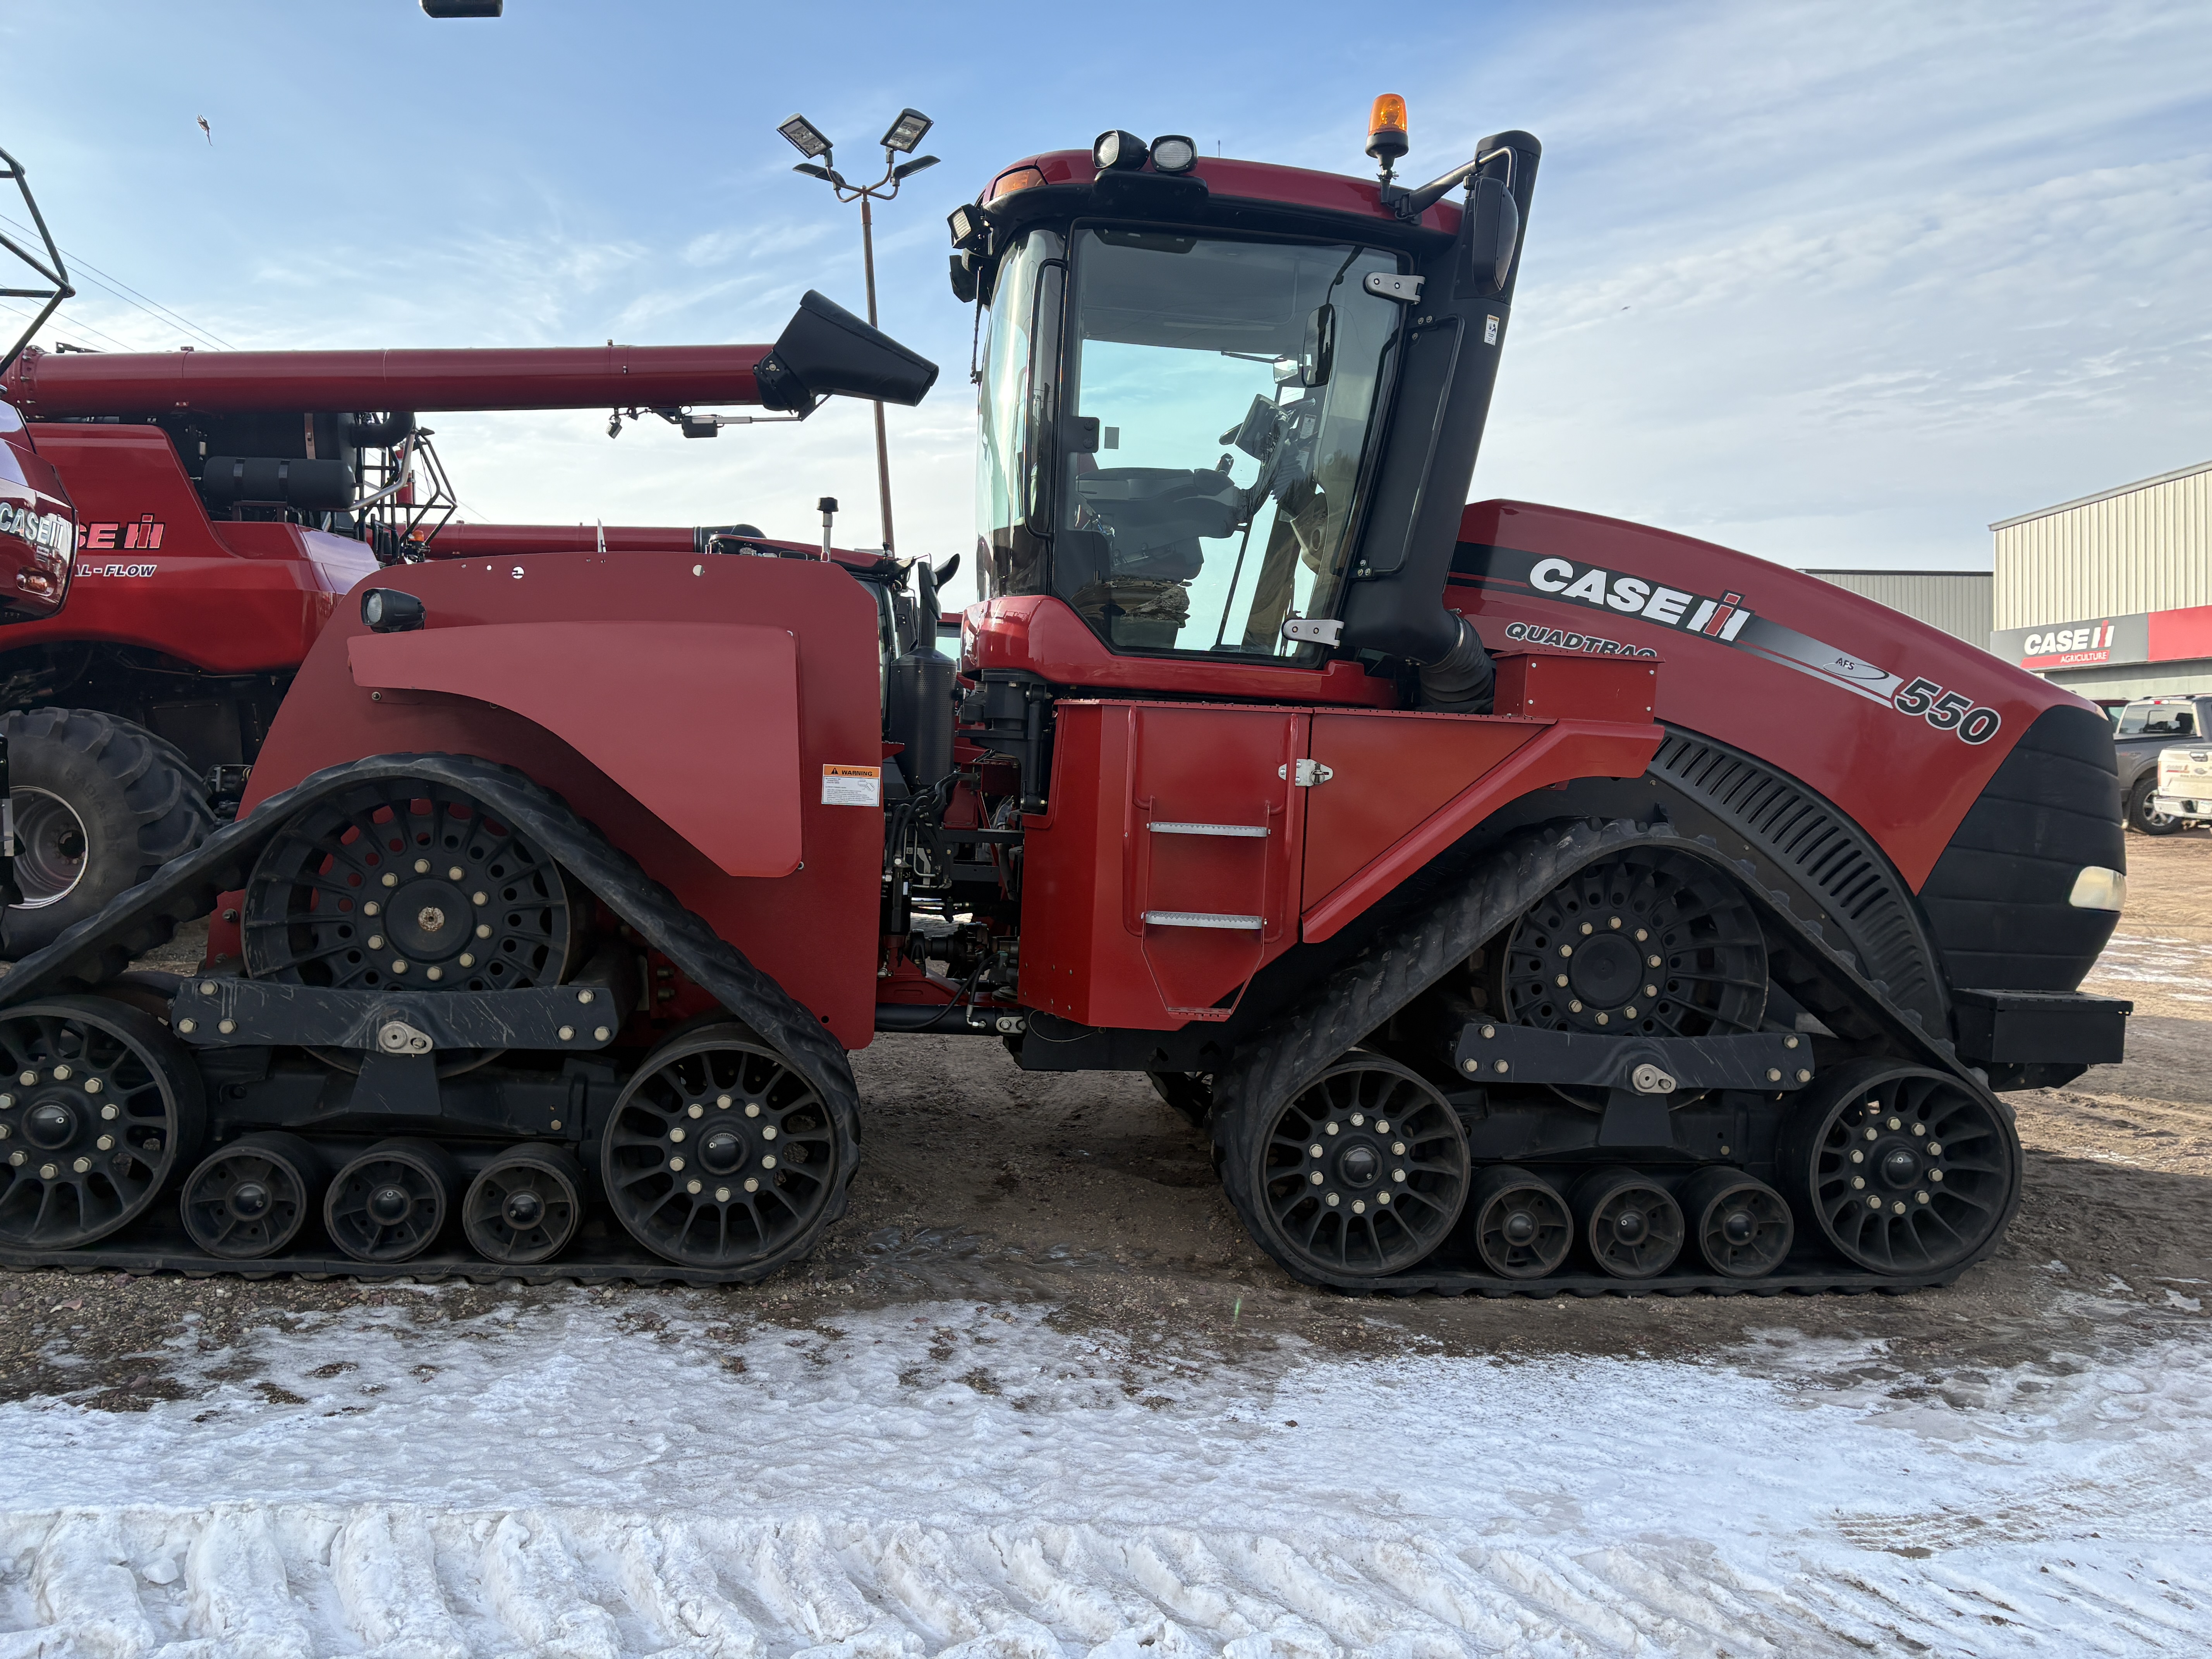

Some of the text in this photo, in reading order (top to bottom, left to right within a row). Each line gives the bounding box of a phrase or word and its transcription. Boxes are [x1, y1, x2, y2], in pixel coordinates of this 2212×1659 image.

[0, 502, 50, 544] CASE
[1530, 558, 1693, 625] CASE
[2024, 628, 2090, 655] CASE
[2060, 651, 2107, 664] AGRICULTURE
[1835, 658, 1855, 670] AFS
[1894, 676, 2002, 745] 550
